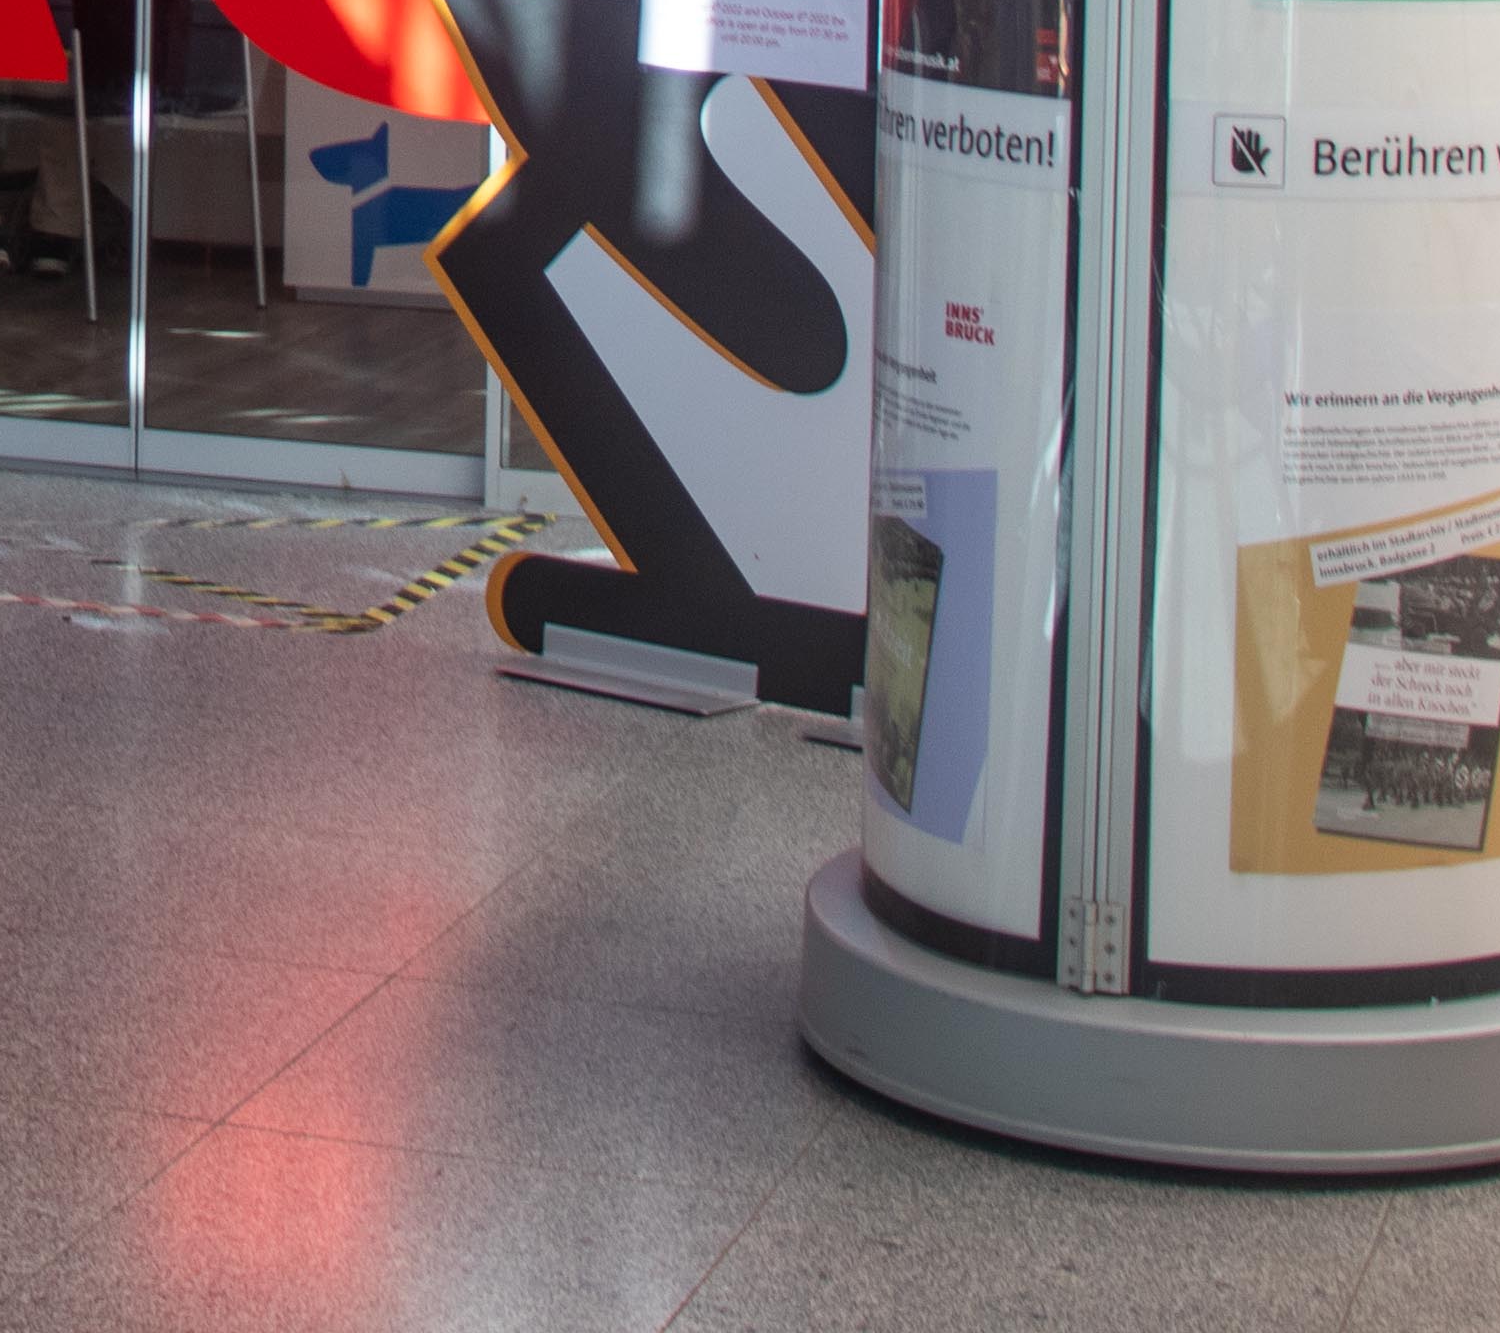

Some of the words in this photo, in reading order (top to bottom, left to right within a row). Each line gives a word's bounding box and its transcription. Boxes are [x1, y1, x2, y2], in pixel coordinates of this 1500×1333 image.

[922, 113, 1054, 167] verboten!
[1313, 135, 1485, 176] Berühren
[945, 320, 996, 346] BRUCK
[1285, 391, 1311, 408] Wir
[1315, 392, 1378, 408] erinnern
[1382, 393, 1401, 406] an
[1402, 389, 1424, 405] die
[1316, 541, 1371, 562] erhältlich
[1388, 524, 1447, 548] Stadtarchiv
[1393, 656, 1421, 674] aber
[1395, 675, 1443, 697] Schreck
[1445, 680, 1474, 699] noch
[1367, 691, 1382, 706] in
[1383, 692, 1415, 711] allen
